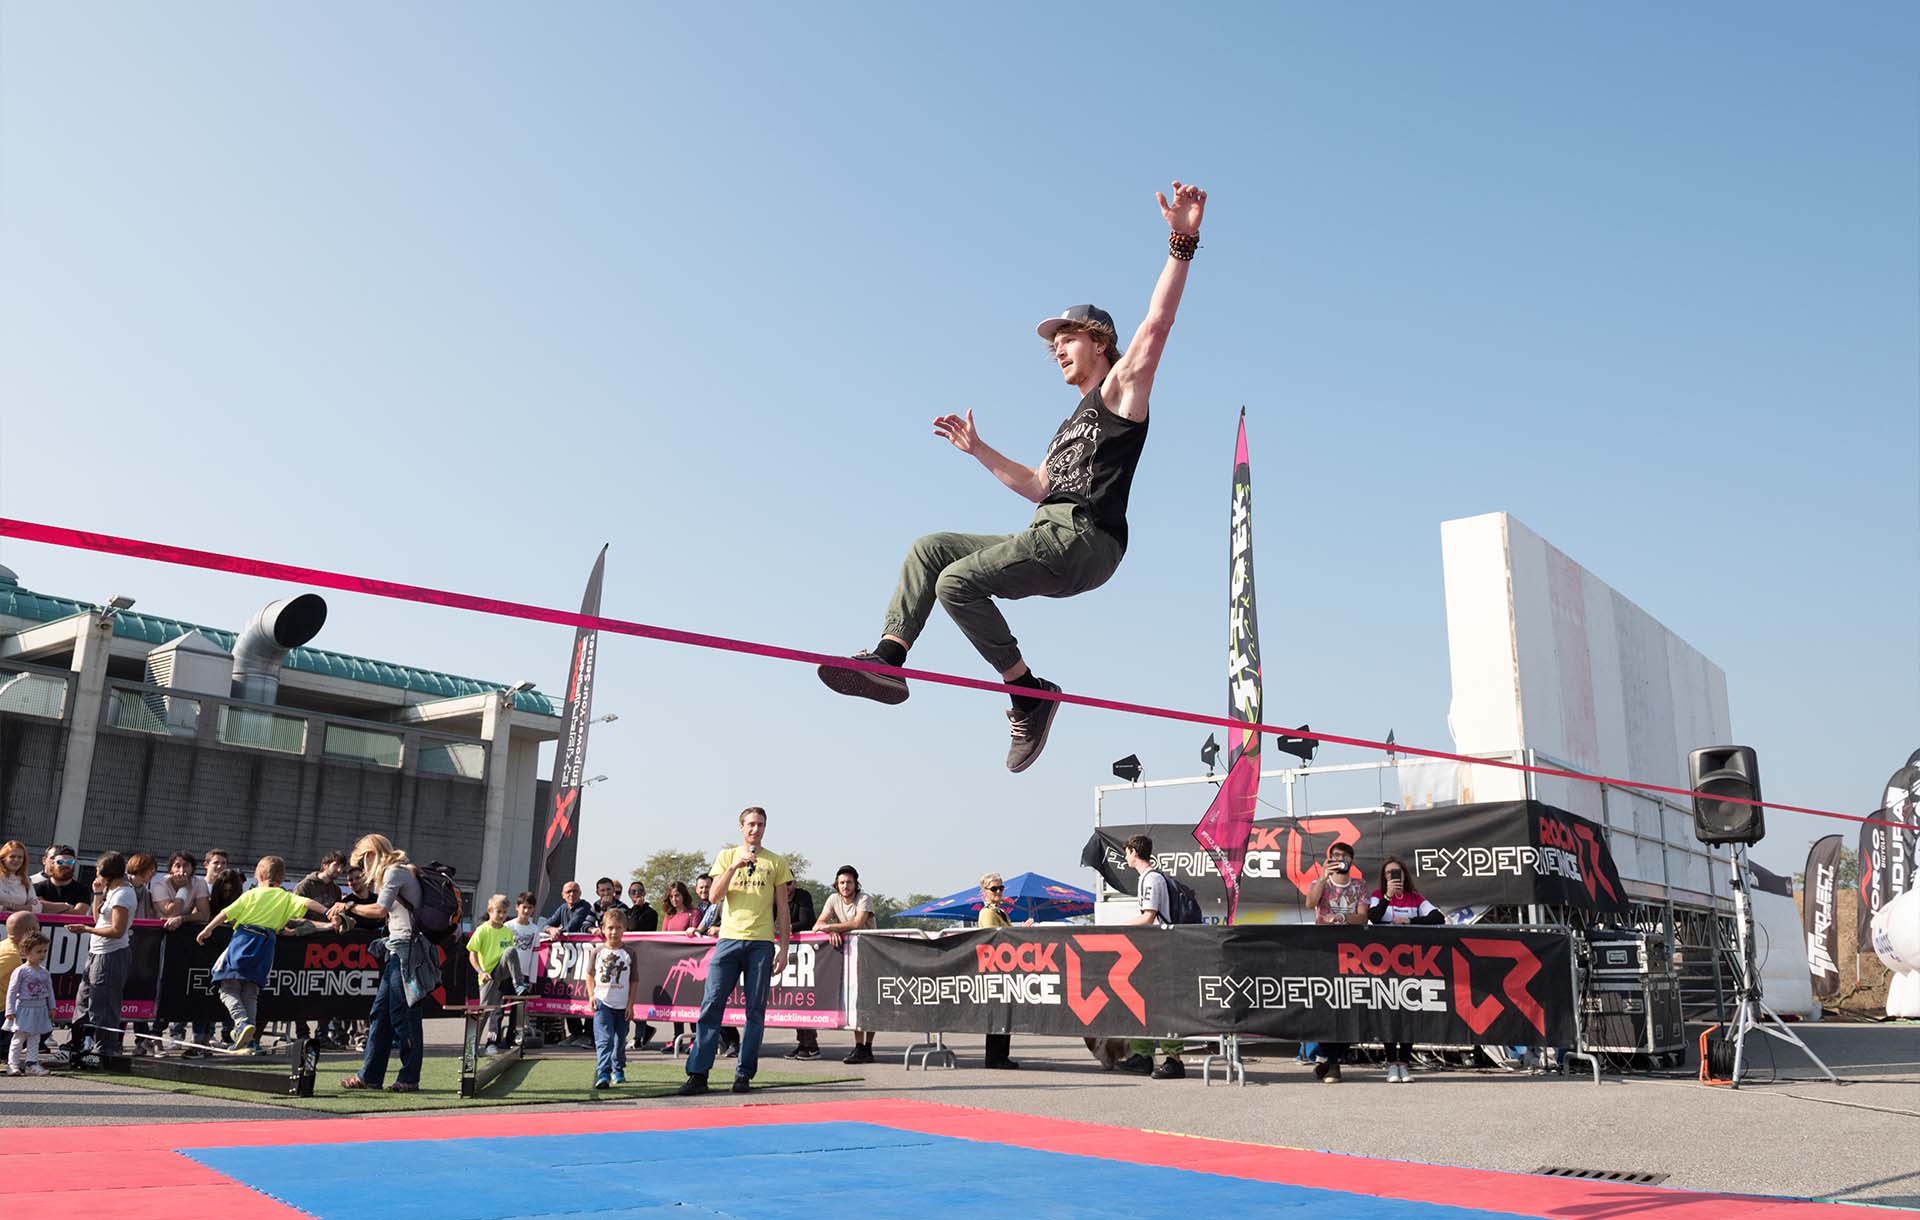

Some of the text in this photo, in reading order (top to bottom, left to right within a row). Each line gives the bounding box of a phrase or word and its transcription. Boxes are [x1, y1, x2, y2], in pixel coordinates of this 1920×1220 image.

[570, 634, 595, 786] Empower Your Senses
[1539, 816, 1577, 852] ROCK
[1415, 846, 1583, 882] EXPERIENCE
[976, 943, 1059, 973] ROCK
[1338, 943, 1444, 977] ROCK
[726, 987, 816, 1007] slalines
[877, 974, 1062, 1005] EXPERIENCE
[1198, 976, 1448, 1012] EXPERIENCE
